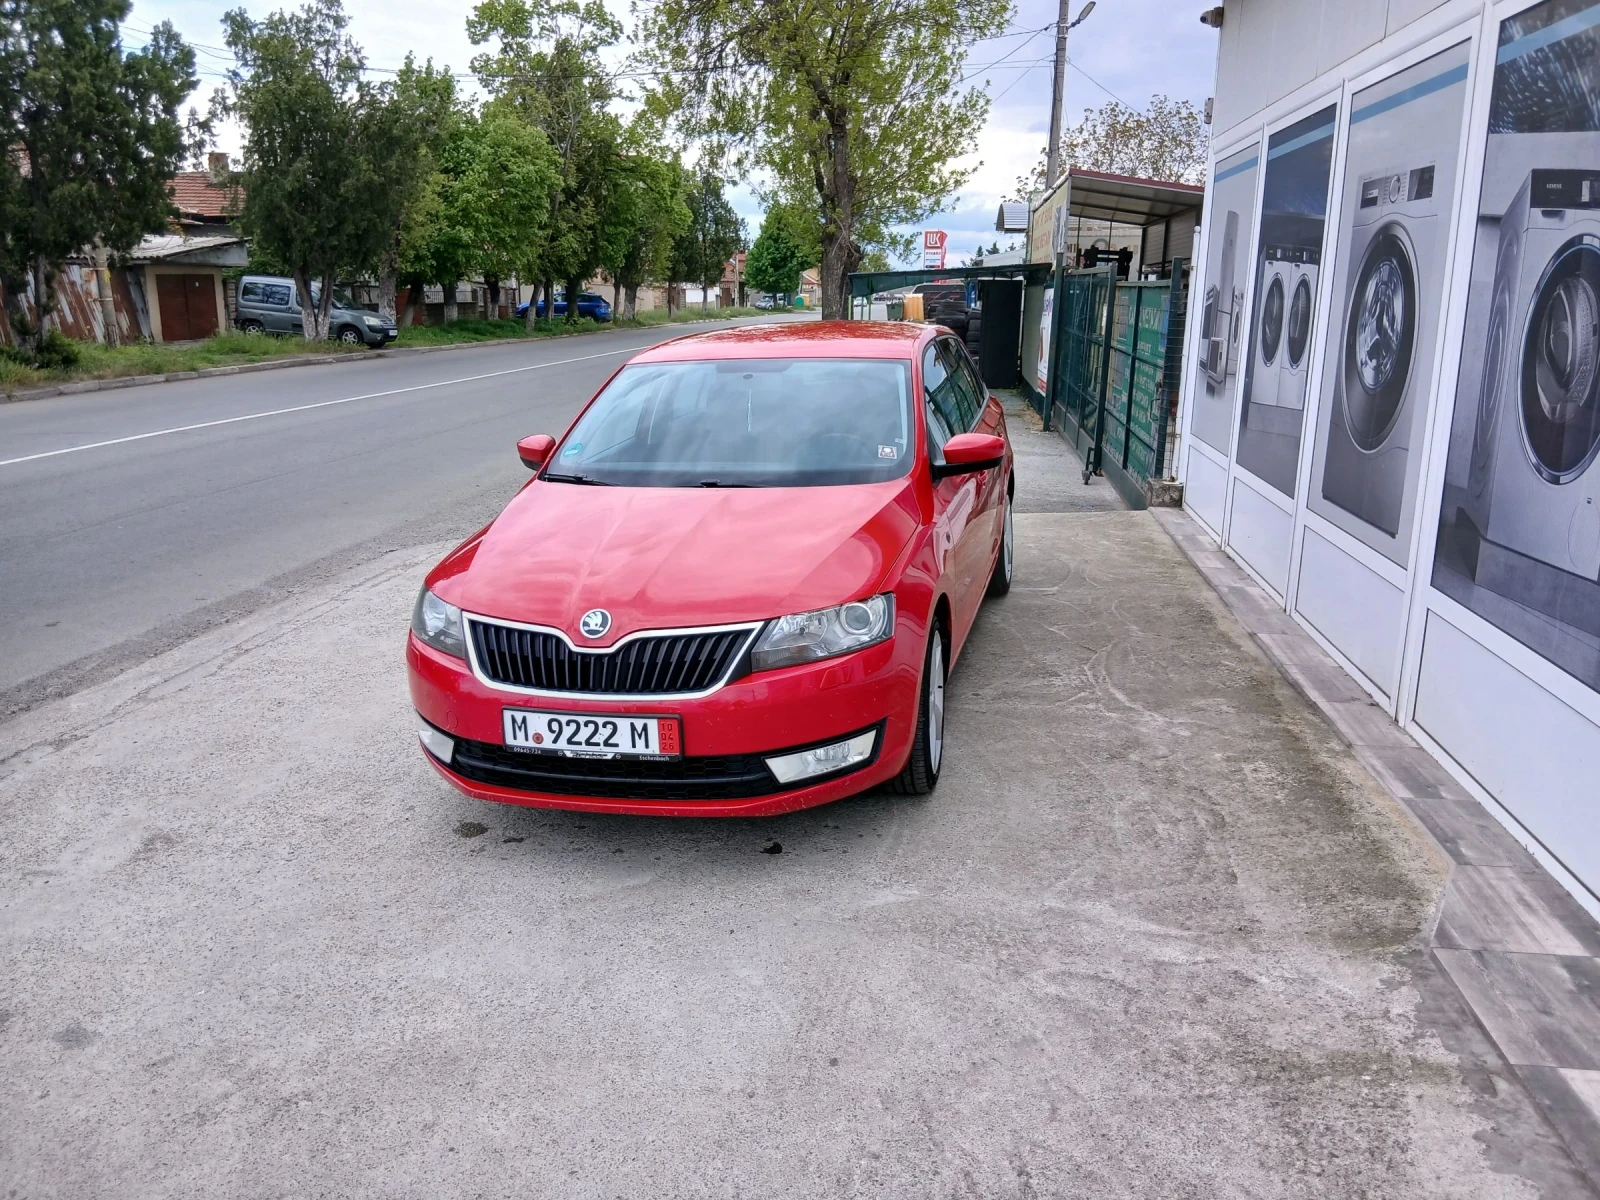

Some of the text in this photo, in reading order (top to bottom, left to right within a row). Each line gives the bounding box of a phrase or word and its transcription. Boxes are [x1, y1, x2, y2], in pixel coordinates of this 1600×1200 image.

[661, 722, 673, 731] 10
[511, 714, 649, 749] M 9222 M
[661, 732, 674, 741] 04
[661, 742, 675, 750] 26
